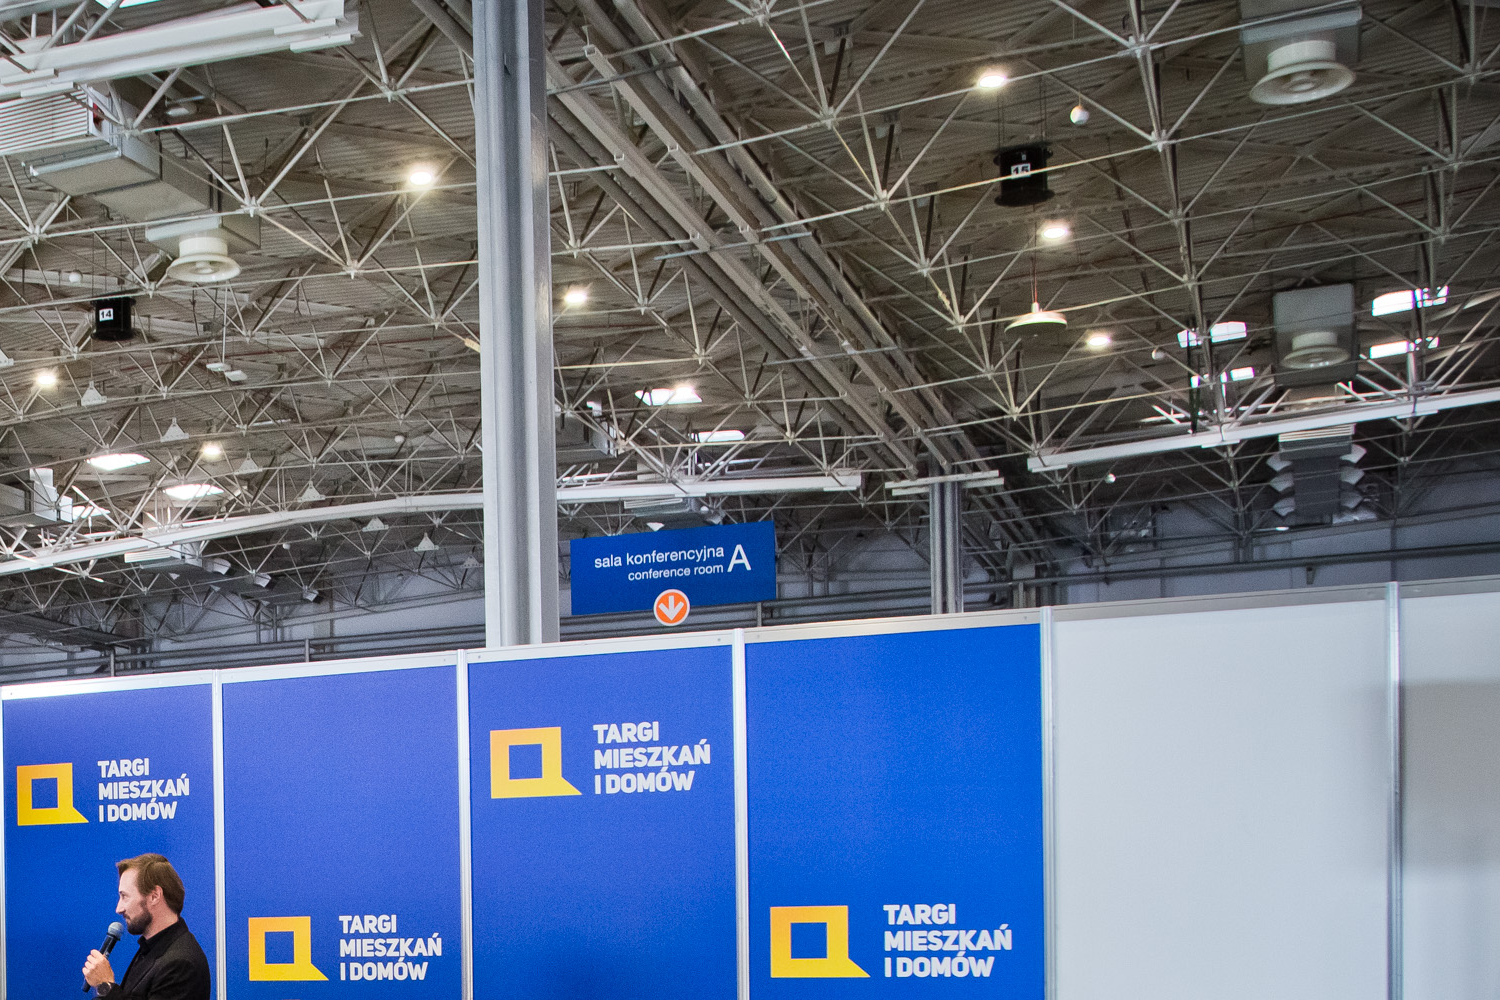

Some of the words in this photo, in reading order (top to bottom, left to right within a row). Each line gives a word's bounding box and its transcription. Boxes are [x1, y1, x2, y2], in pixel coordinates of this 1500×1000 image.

[101, 310, 112, 319] 14
[595, 554, 622, 568] sala
[626, 546, 724, 566] konferencyjna
[727, 544, 752, 572] A
[628, 568, 691, 581] conference
[694, 564, 724, 576] room
[593, 721, 659, 744] TARGI
[594, 738, 711, 770] MIESZKAŃ
[98, 758, 150, 778] TARGI
[98, 773, 190, 801] MIESZKAŃ
[594, 775, 601, 795] I
[605, 769, 695, 795] DOMÓW
[98, 805, 105, 823] I
[107, 800, 178, 822] DOMÓW
[339, 915, 397, 934] TARGI
[883, 903, 956, 926] TARGI
[339, 932, 443, 958] MIESZKAŃ
[884, 923, 1013, 952] MIESZKAŃ
[340, 963, 346, 981] I
[349, 957, 429, 981] DOMÓW
[885, 957, 892, 978] I
[896, 952, 995, 978] DOMÓW
